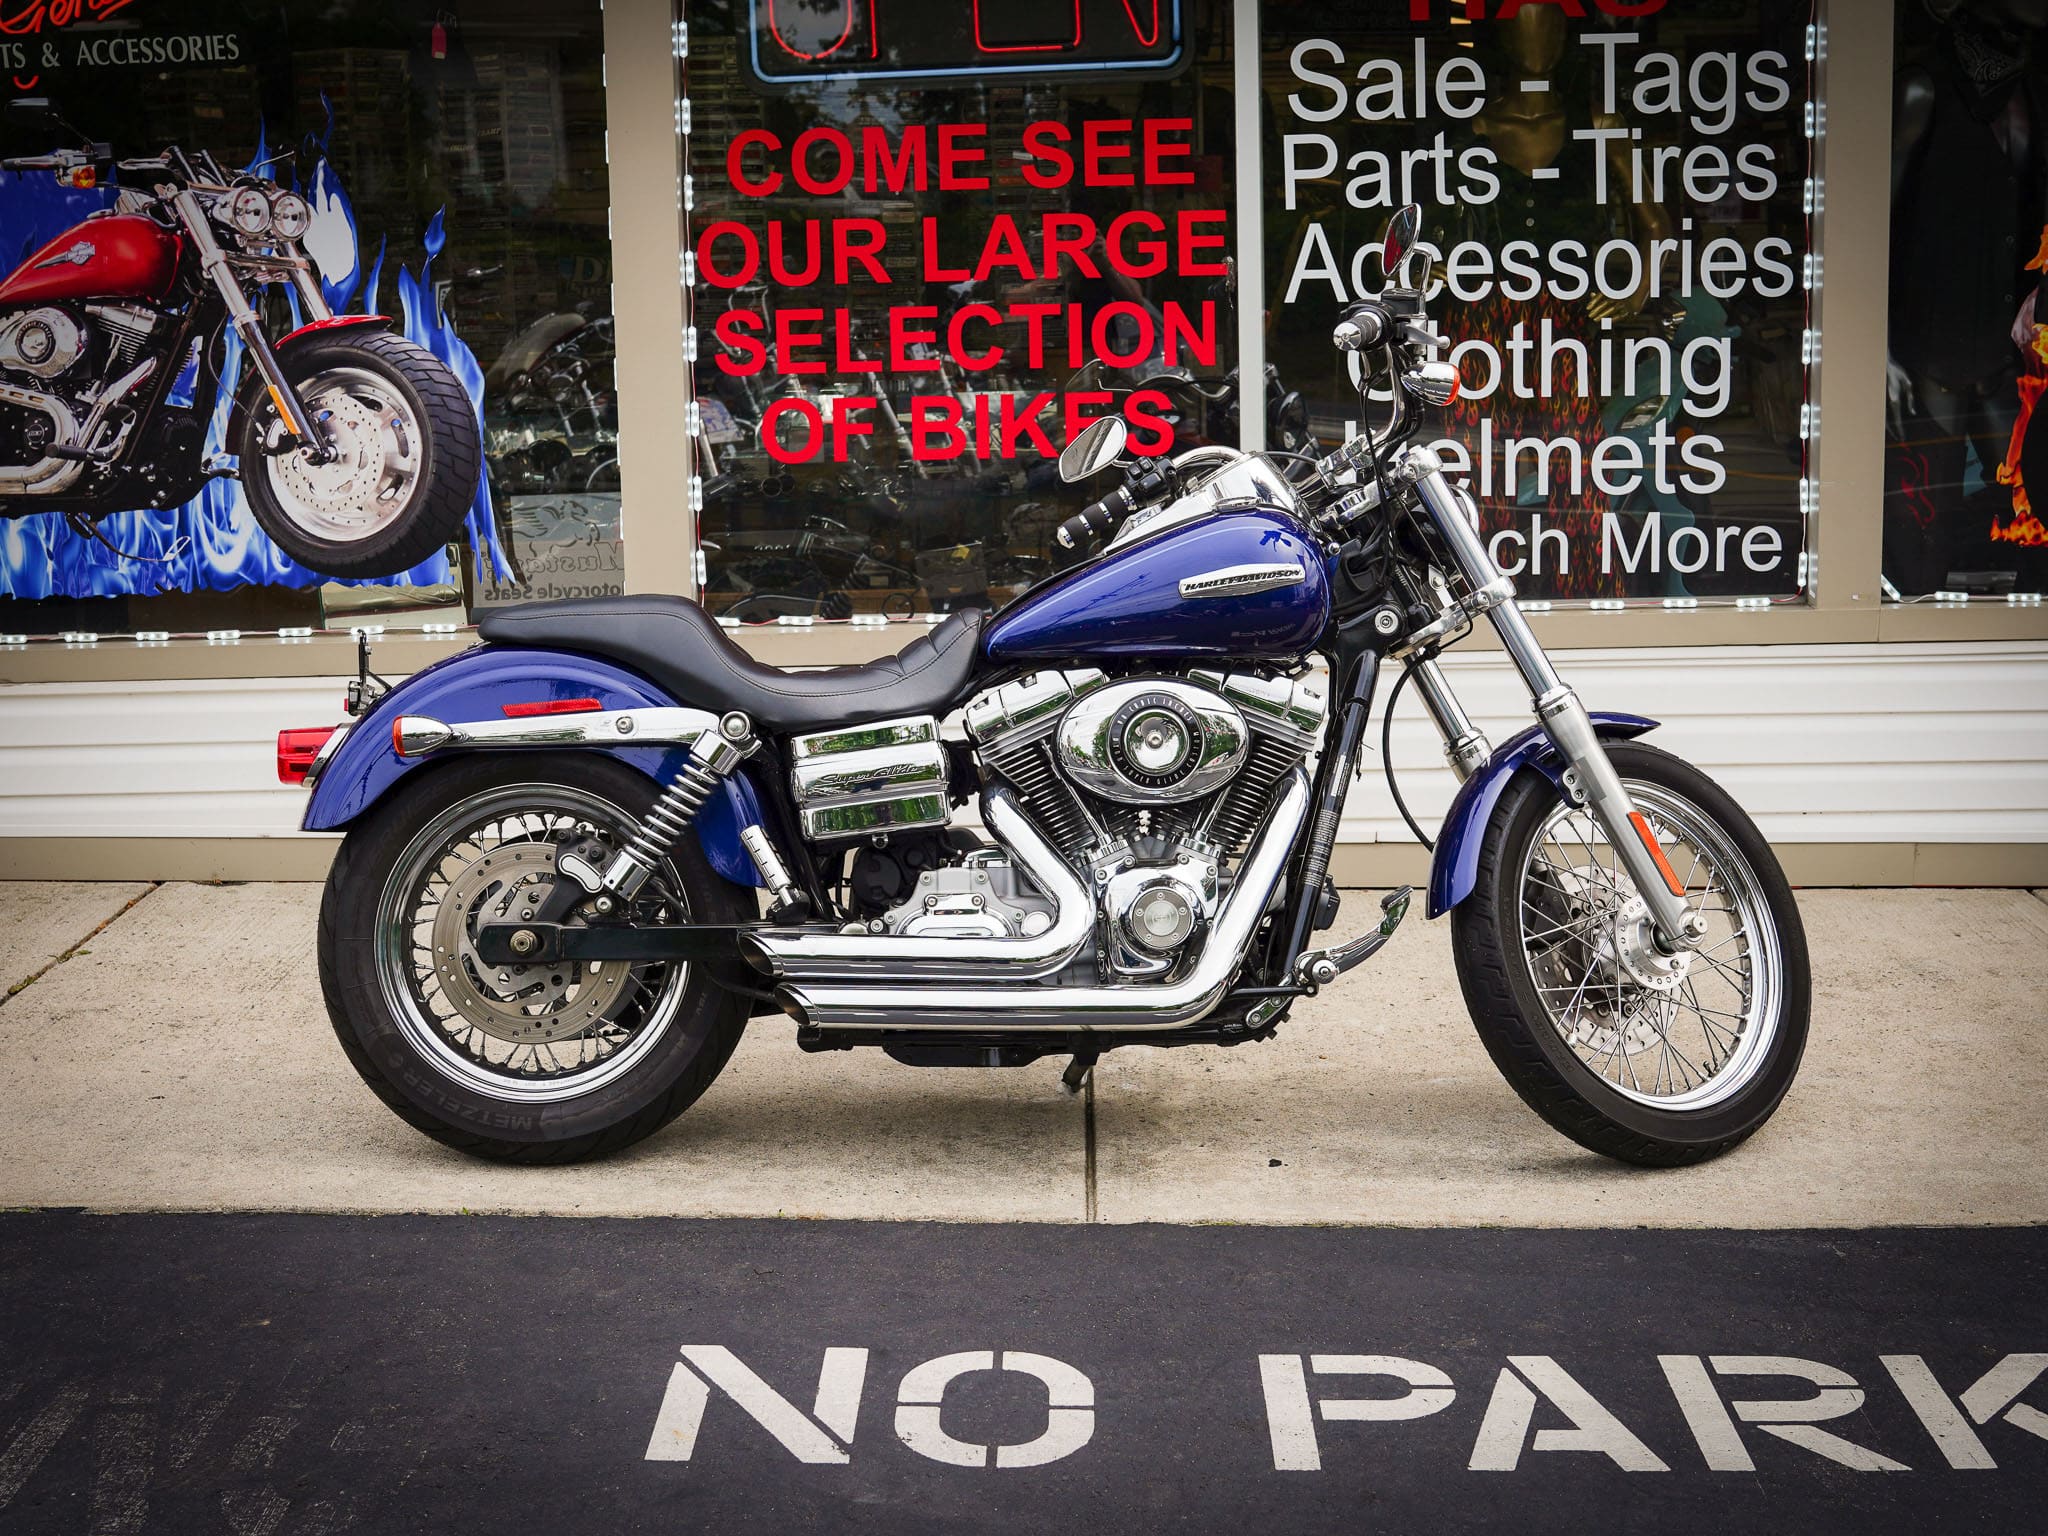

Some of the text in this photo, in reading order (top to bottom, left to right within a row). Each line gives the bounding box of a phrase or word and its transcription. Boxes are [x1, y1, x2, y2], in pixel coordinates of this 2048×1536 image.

[41, 41, 61, 68] &
[77, 34, 240, 66] ACCESSORIES
[1288, 38, 1486, 121] Sale
[1580, 33, 1789, 135] Tags
[727, 118, 1195, 197] COME SEE
[1284, 131, 1500, 210] Parts
[1573, 128, 1777, 204] Tires
[697, 218, 892, 289] OUR
[923, 209, 1229, 282] LARGE
[1285, 218, 1793, 304] Accessories
[714, 301, 1217, 377] SELECTION
[760, 390, 1175, 465] OF BIKES
[1489, 511, 1783, 578] ch More
[645, 1344, 2048, 1472] NO PARK
